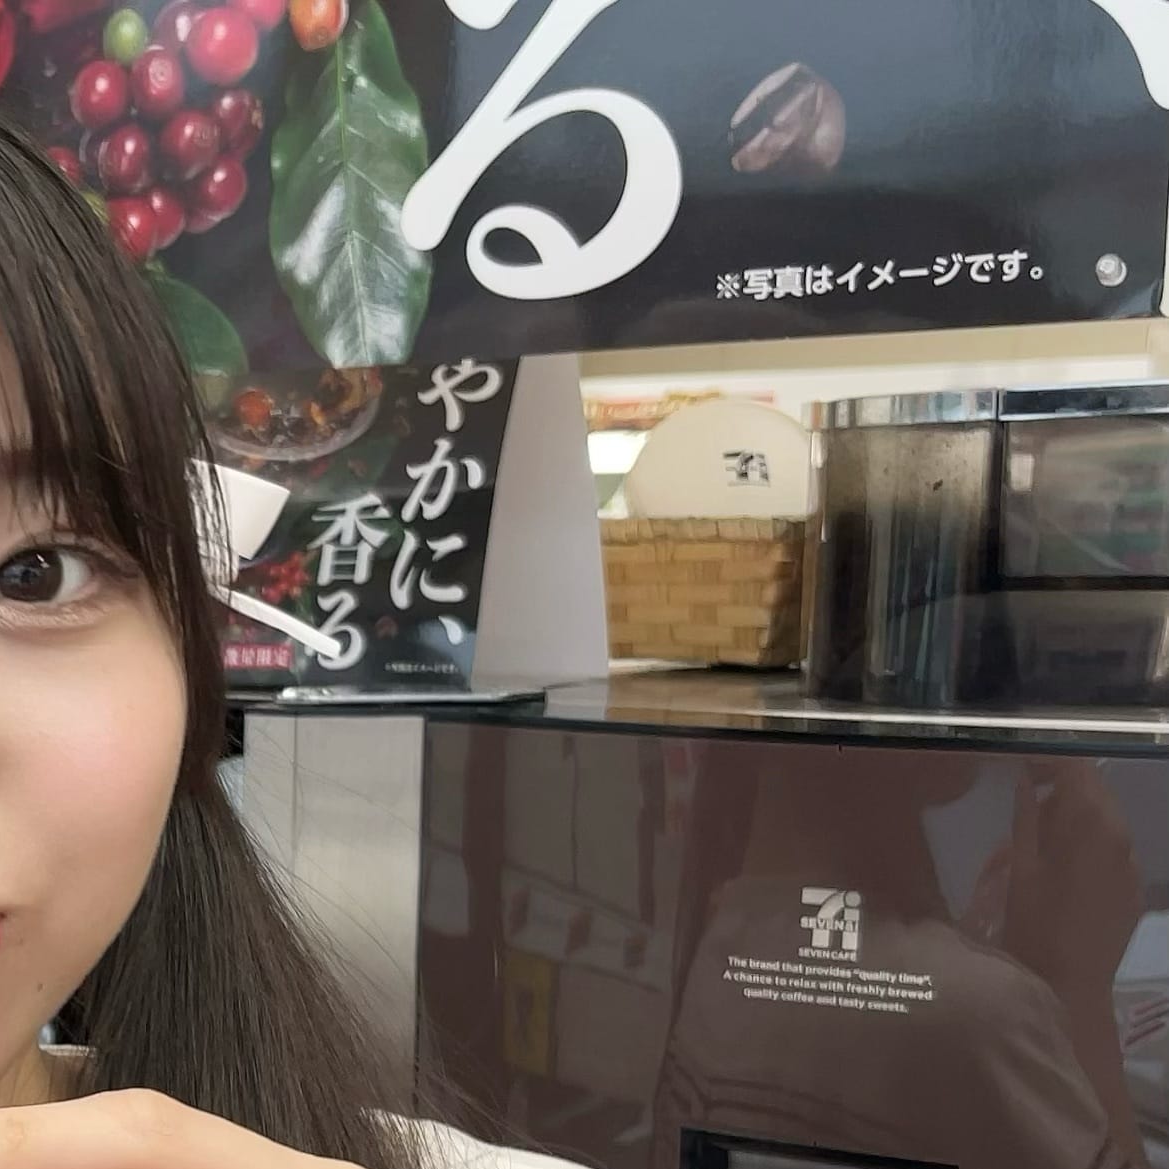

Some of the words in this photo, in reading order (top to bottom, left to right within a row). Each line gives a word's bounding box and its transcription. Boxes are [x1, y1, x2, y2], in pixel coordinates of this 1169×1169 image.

[716, 249, 1044, 300] ※写真はイメージです。
[306, 493, 393, 671] 香る
[728, 955, 748, 968] The
[749, 958, 780, 972] brand
[782, 962, 803, 974] that
[805, 965, 851, 979] provides
[798, 947, 830, 959] SEVEN
[723, 970, 732, 980] A
[733, 971, 772, 985] chance
[775, 975, 787, 986] to
[788, 977, 816, 989] relax
[818, 980, 844, 993] with
[846, 982, 886, 998] freshly
[888, 986, 933, 1001] brewed
[743, 988, 779, 1001] quality
[781, 991, 814, 1003] coffee
[816, 995, 836, 1007] and
[838, 997, 865, 1009] tasty
[868, 1002, 909, 1014] sweets.
